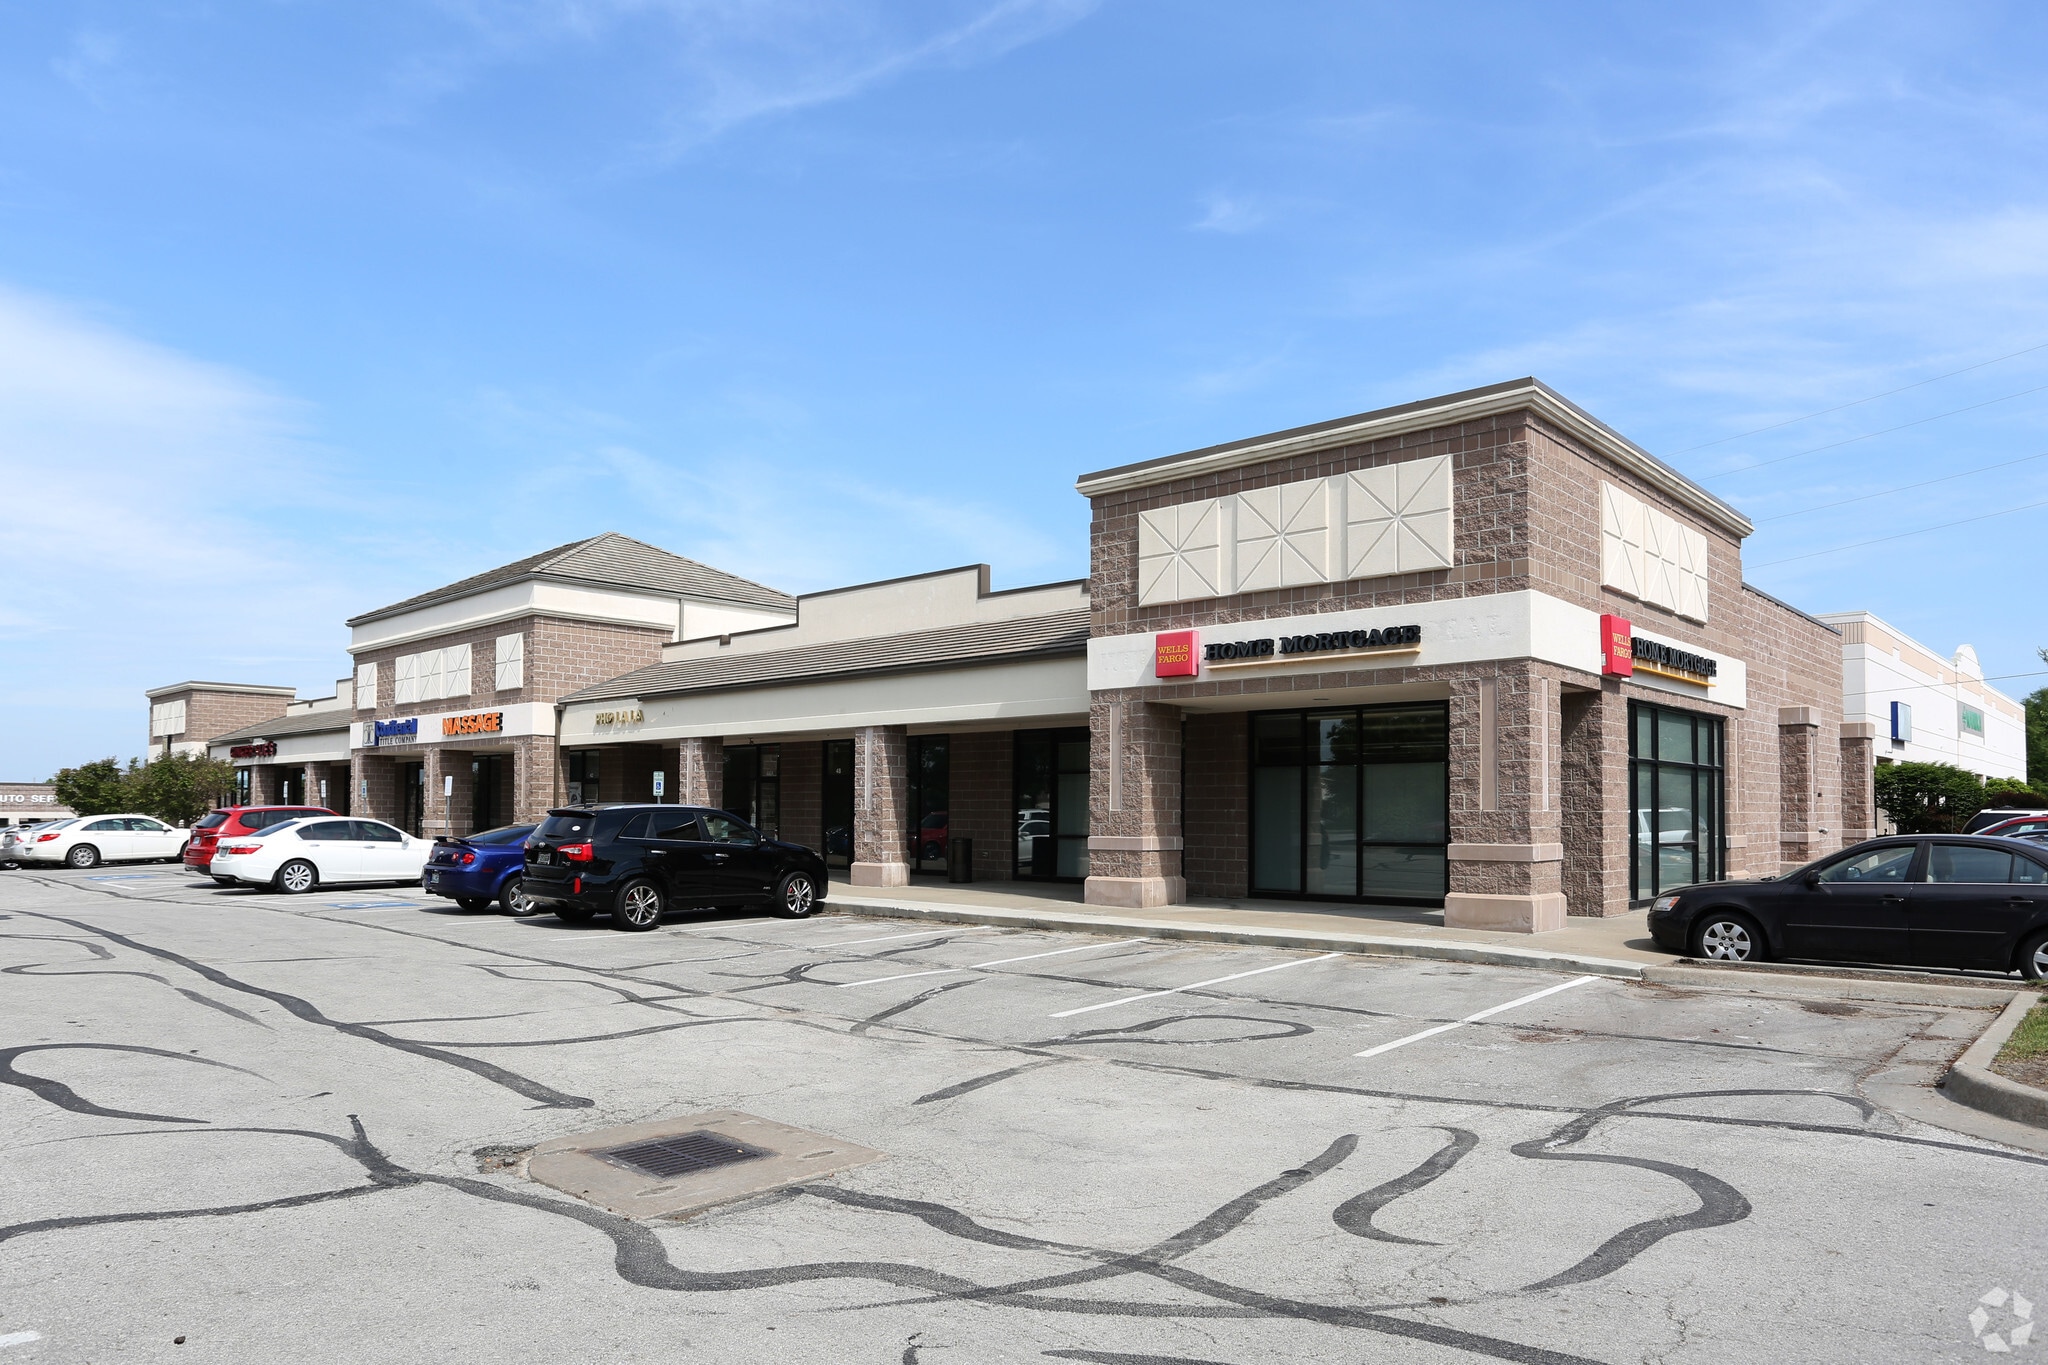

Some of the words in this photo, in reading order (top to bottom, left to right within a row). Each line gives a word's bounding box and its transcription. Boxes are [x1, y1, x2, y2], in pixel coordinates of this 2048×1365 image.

[1204, 638, 1275, 661] HOME
[1279, 625, 1421, 654] MORTGAGE
[1613, 632, 1631, 647] WELLS
[1158, 644, 1189, 654] WELLS
[1613, 645, 1632, 660] FARGO
[1158, 654, 1189, 664] FARGO
[1632, 637, 1667, 664] HOME
[1669, 646, 1717, 677] MORTGAGE
[442, 712, 503, 735] MASSAGE
[380, 737, 393, 746] TITLE
[394, 735, 417, 744] COMPANY
[0, 794, 25, 803] UTO
